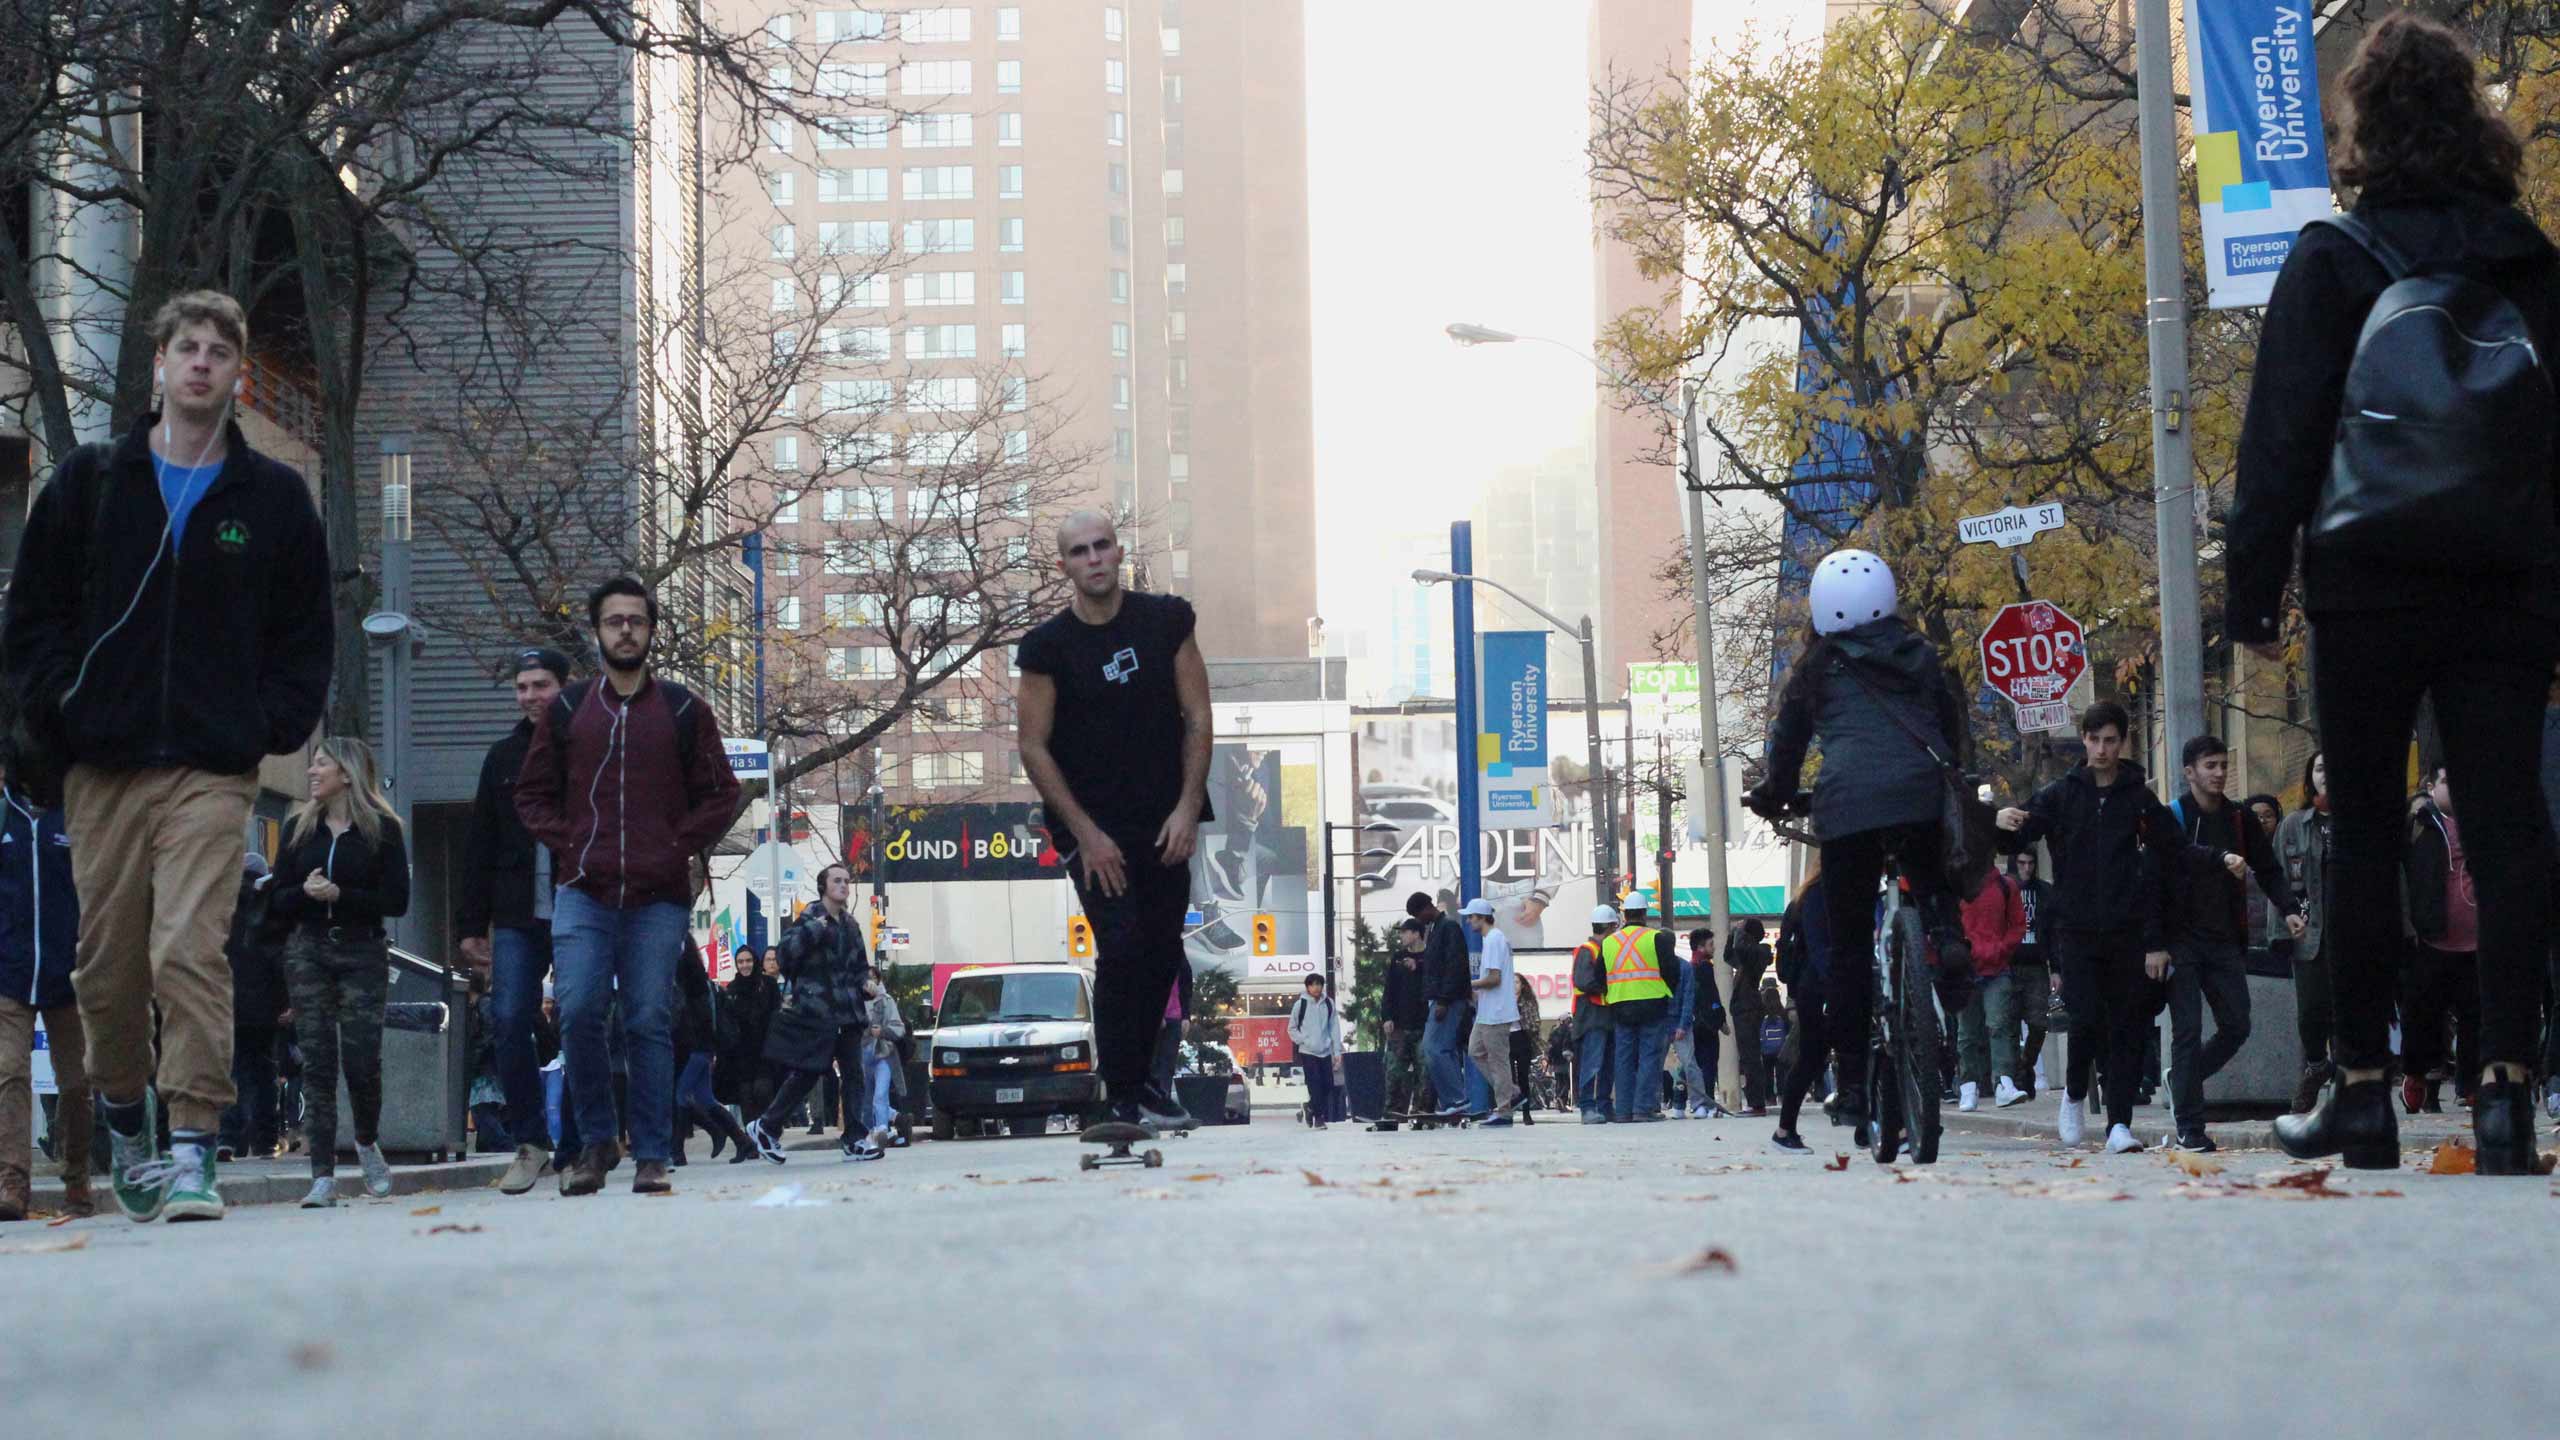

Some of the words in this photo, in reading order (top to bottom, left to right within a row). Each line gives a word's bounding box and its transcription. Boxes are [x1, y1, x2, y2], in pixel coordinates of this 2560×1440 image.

[2251, 36, 2286, 161] Ryerson
[2271, 5, 2309, 160] University
[2231, 240, 2289, 257] Ryerson
[1964, 513, 2028, 538] VICTORIA
[1989, 631, 2076, 677] STOP
[1634, 670, 1678, 688] FOR
[1508, 680, 1525, 752] Ryerson
[1522, 663, 1541, 752] University
[1264, 961, 1316, 973] ALDO
